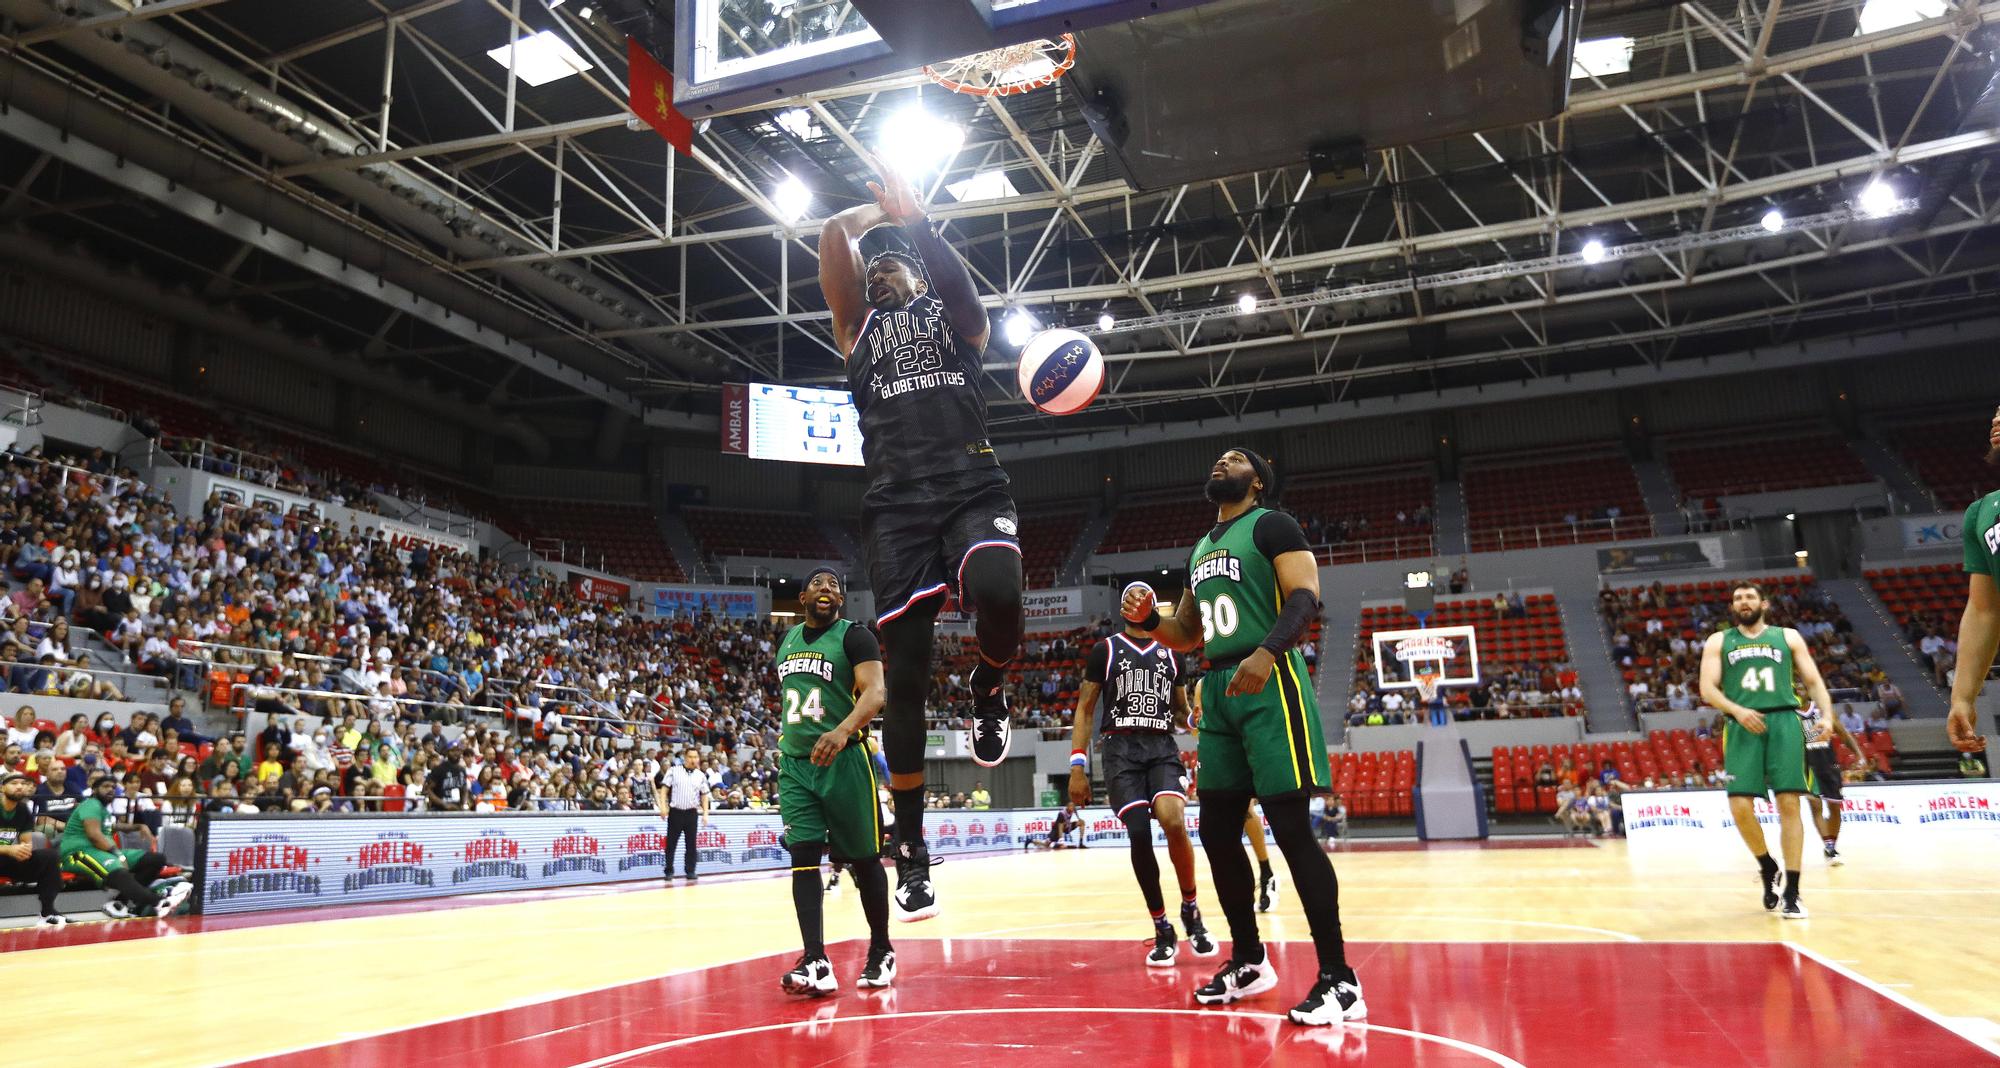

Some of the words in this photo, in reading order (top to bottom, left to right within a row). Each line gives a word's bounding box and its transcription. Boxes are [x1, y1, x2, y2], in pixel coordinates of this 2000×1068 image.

[868, 311, 957, 365] HARLEM
[893, 340, 943, 377] 23
[881, 372, 965, 400] GLOBETROTTERS
[729, 399, 742, 450] AMBAR
[1022, 594, 1068, 607] Zaragoza
[1200, 593, 1240, 643] 30
[778, 658, 833, 682] GENERALS
[1741, 667, 1775, 692] 41
[1116, 669, 1172, 704] HARLEM
[785, 687, 826, 725] 24
[1128, 693, 1157, 717] 38
[1115, 717, 1168, 731] GLOBETROTTERS
[1637, 804, 1691, 818] HARLEM
[1928, 796, 1990, 811] HARLEM
[228, 843, 308, 876] HARLEM
[358, 841, 424, 869] HARLEM
[465, 838, 519, 864] HARLEM
[553, 835, 599, 859] HARLEM
